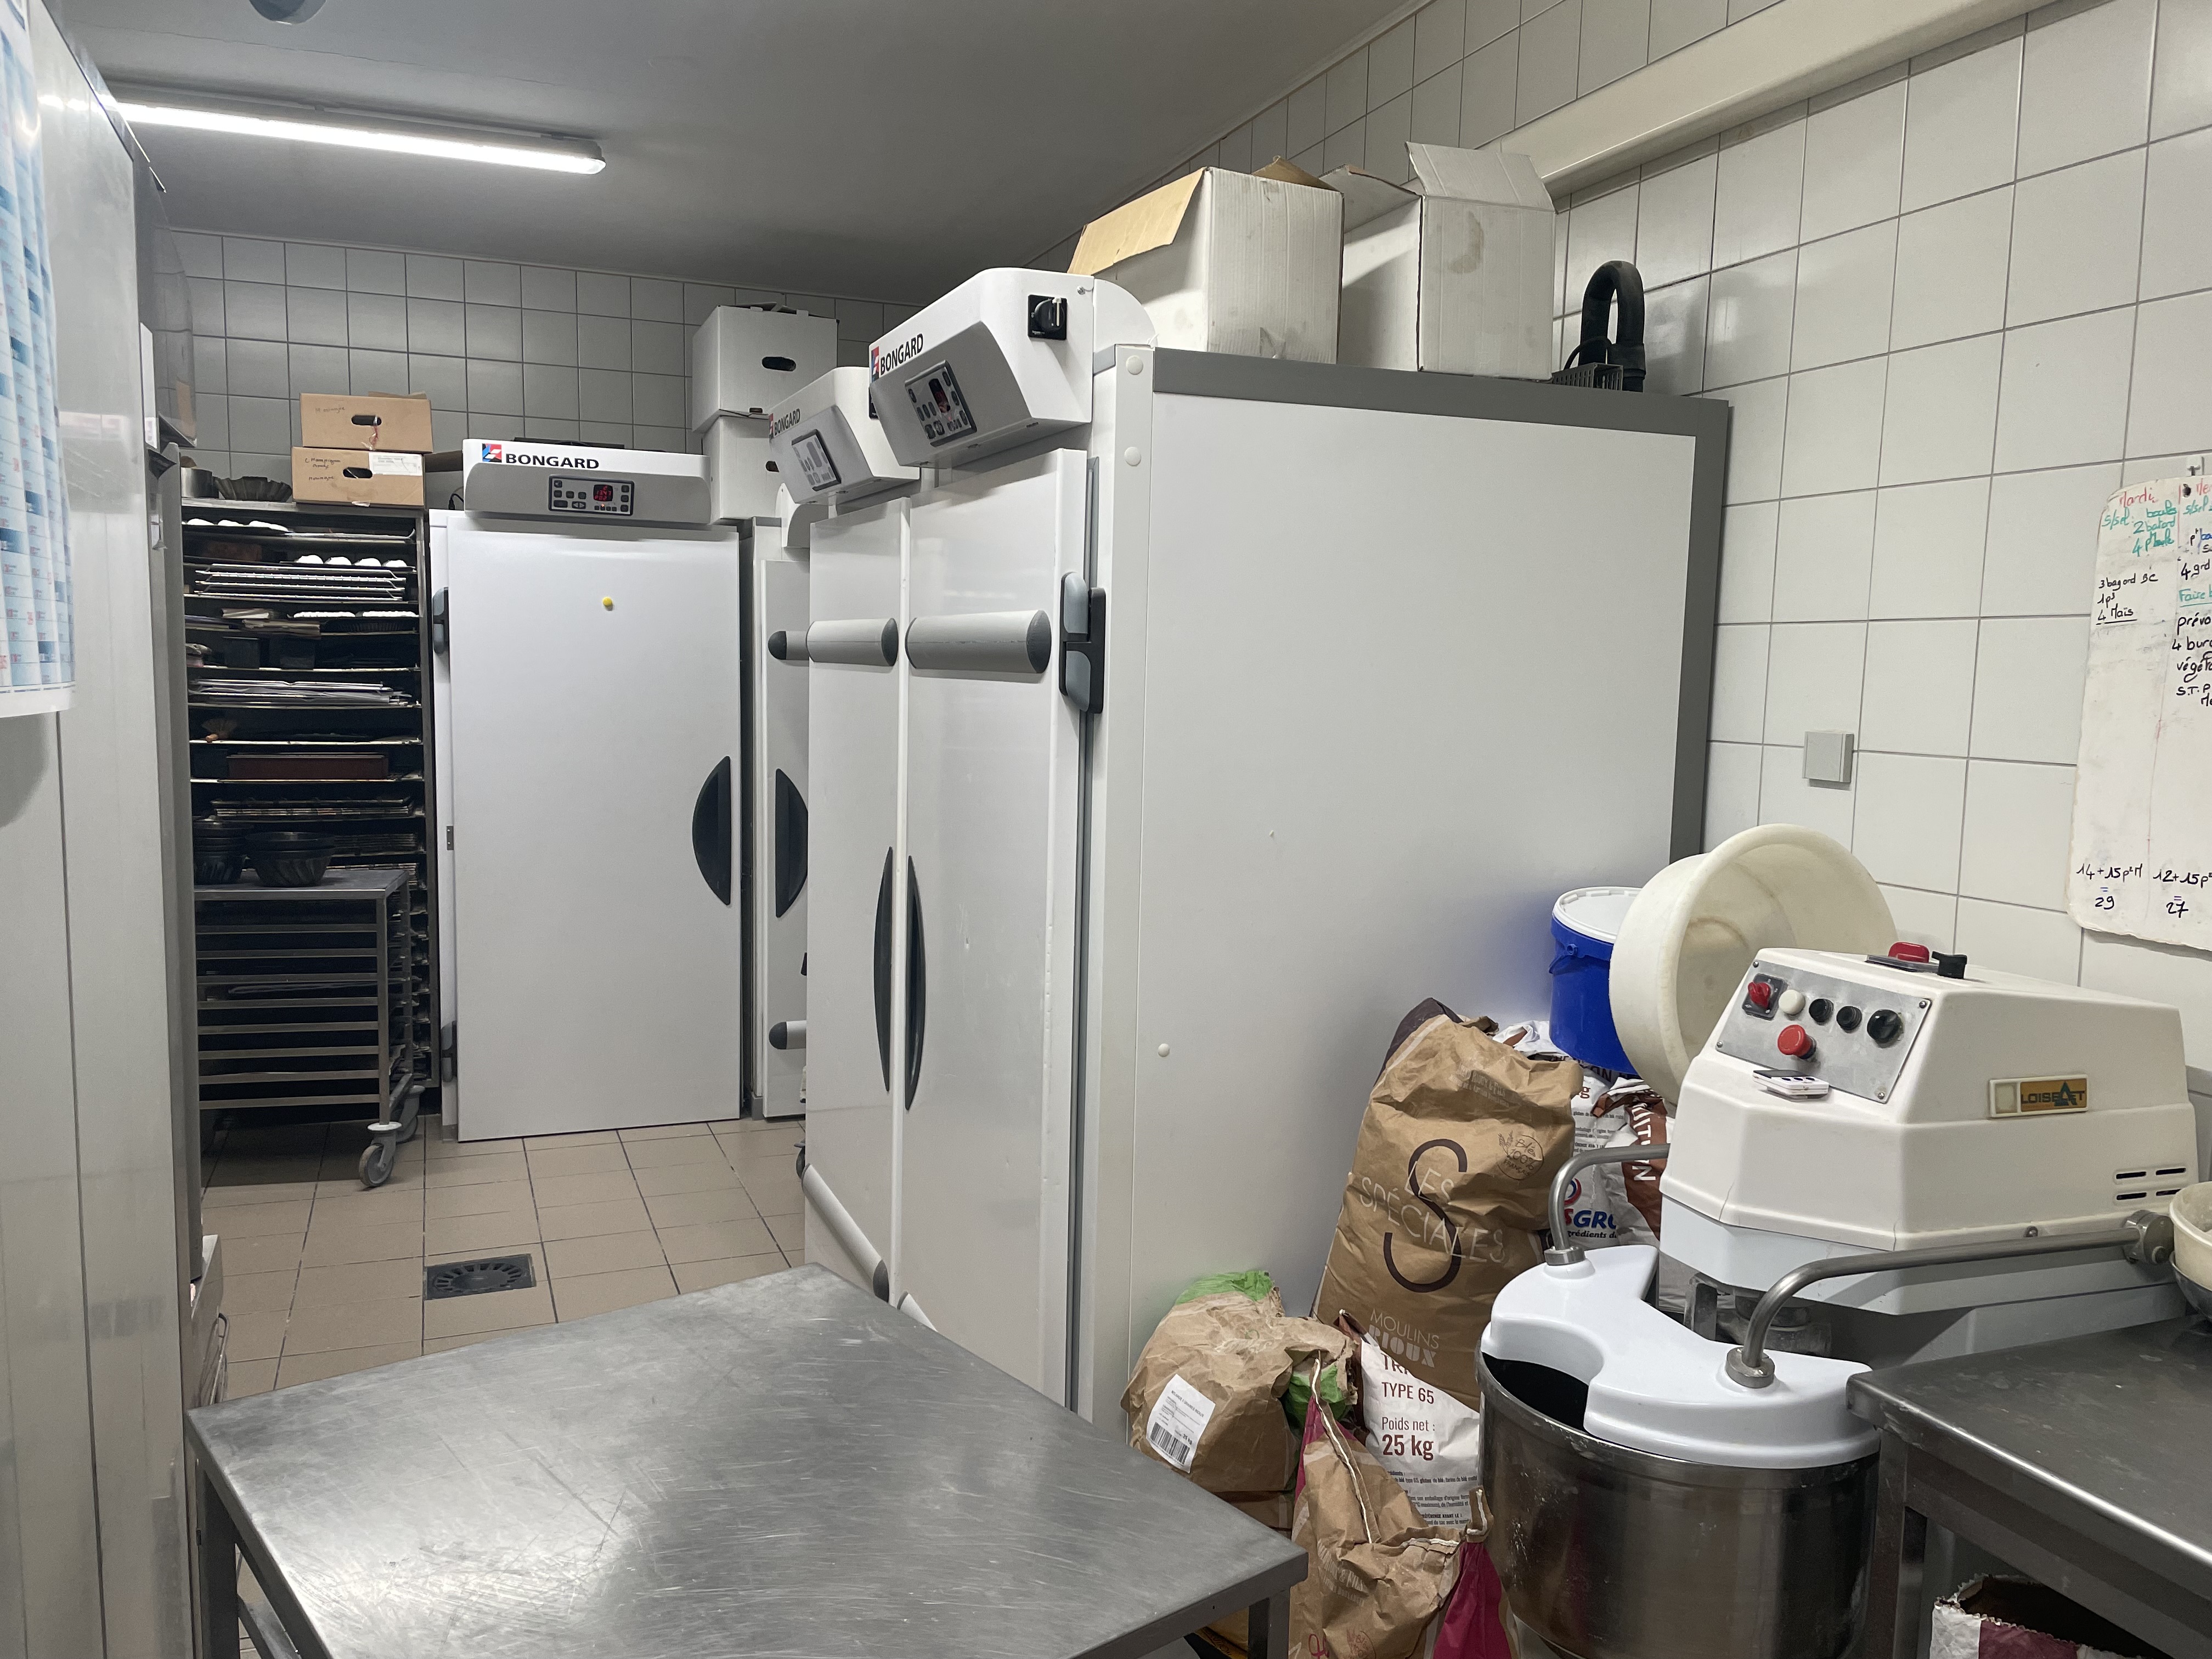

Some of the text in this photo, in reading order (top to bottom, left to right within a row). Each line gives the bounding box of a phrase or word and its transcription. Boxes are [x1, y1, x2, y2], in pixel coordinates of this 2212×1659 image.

[880, 333, 924, 376] BONGARD
[774, 408, 800, 436] BONGARD
[505, 453, 600, 469] BONGARD
[2196, 478, 2212, 496] Me
[2095, 895, 2114, 910] 29
[2166, 901, 2189, 918] 27
[1404, 1161, 1454, 1205] LES
[1359, 1177, 1506, 1263] SPÉCIALES
[1370, 1308, 1440, 1349] MOULINS
[1369, 1324, 1436, 1368] RIOUX
[1381, 1352, 1408, 1375] TR
[1381, 1381, 1434, 1404] TYPE 65
[1382, 1417, 1409, 1430] Poids
[1413, 1420, 1429, 1431] net
[1382, 1434, 1434, 1461] 25 kg
